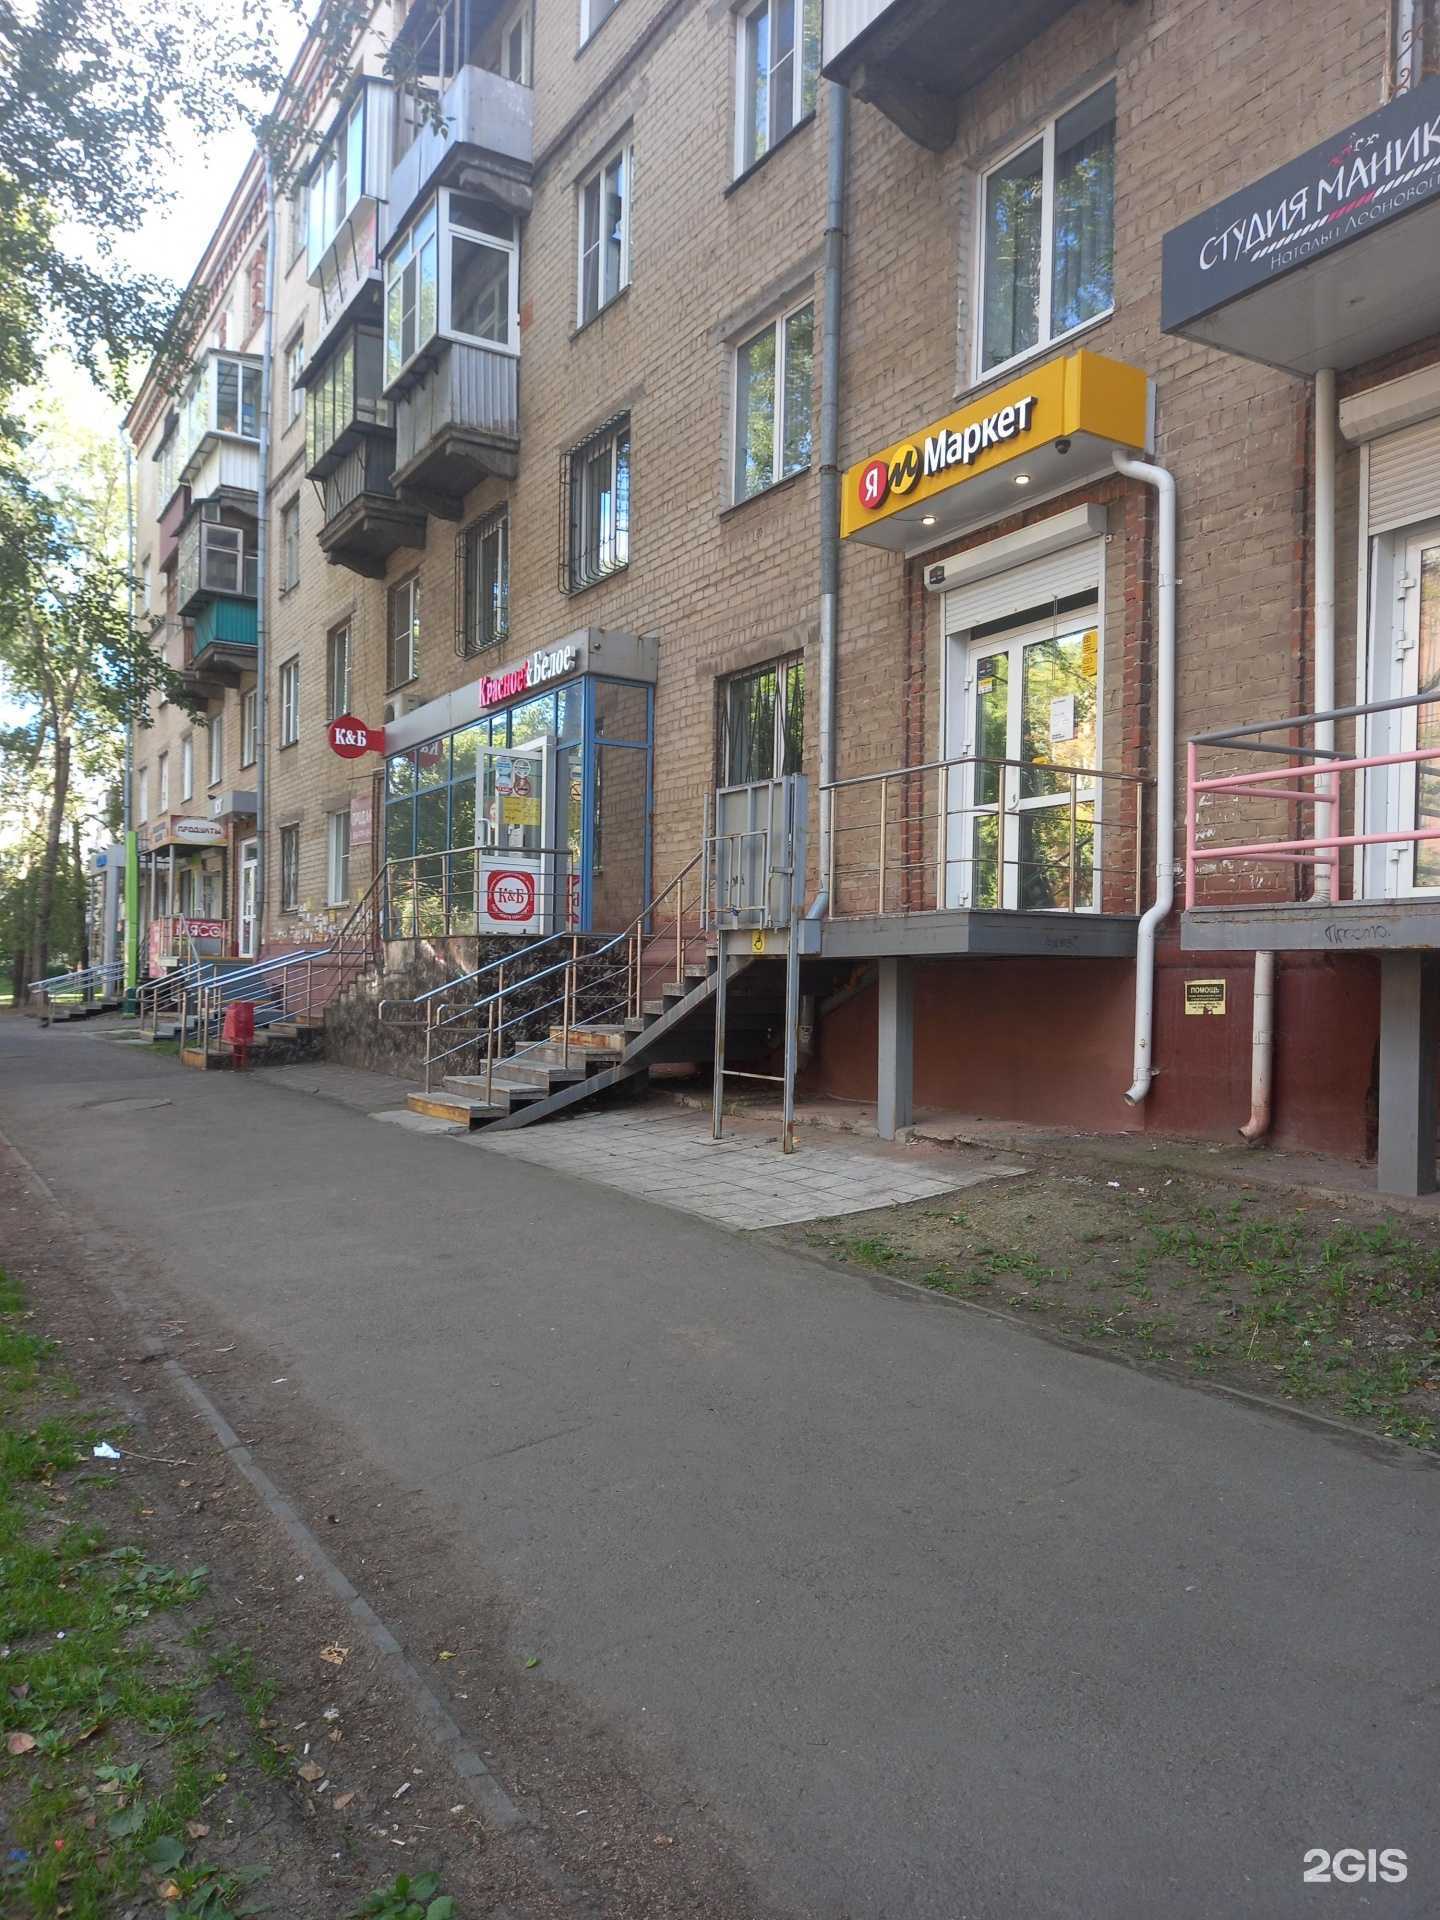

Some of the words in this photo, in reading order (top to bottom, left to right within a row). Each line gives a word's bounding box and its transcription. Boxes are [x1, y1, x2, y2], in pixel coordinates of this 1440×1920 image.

[1200, 186, 1309, 270] СТУДИЯ
[1317, 114, 1440, 213] МАНИК
[864, 466, 878, 501] Я
[923, 396, 1033, 476] Маркет
[334, 727, 367, 747] К&Б
